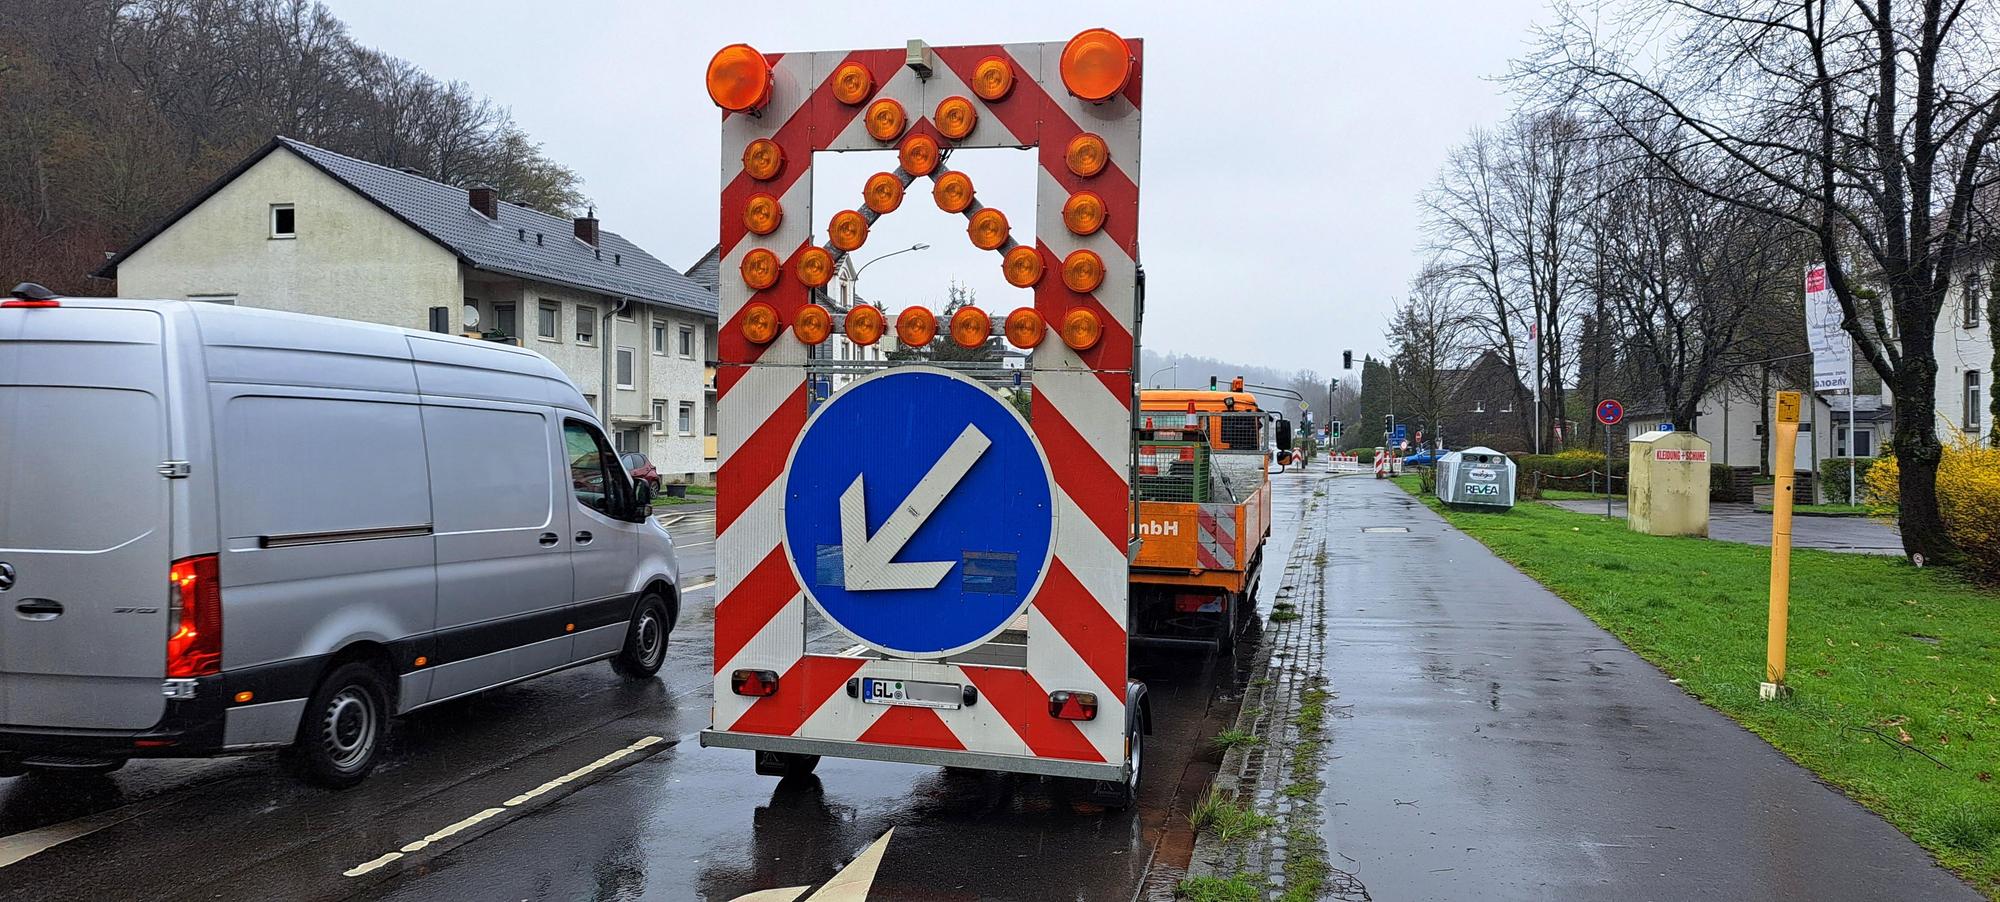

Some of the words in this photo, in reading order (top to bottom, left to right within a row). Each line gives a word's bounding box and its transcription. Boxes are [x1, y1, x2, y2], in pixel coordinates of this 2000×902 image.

[1656, 450, 1681, 460] KLEIDUNG
[1686, 451, 1706, 461] SCHUHE
[1465, 484, 1499, 495] REVEA
[873, 682, 893, 698] GL
